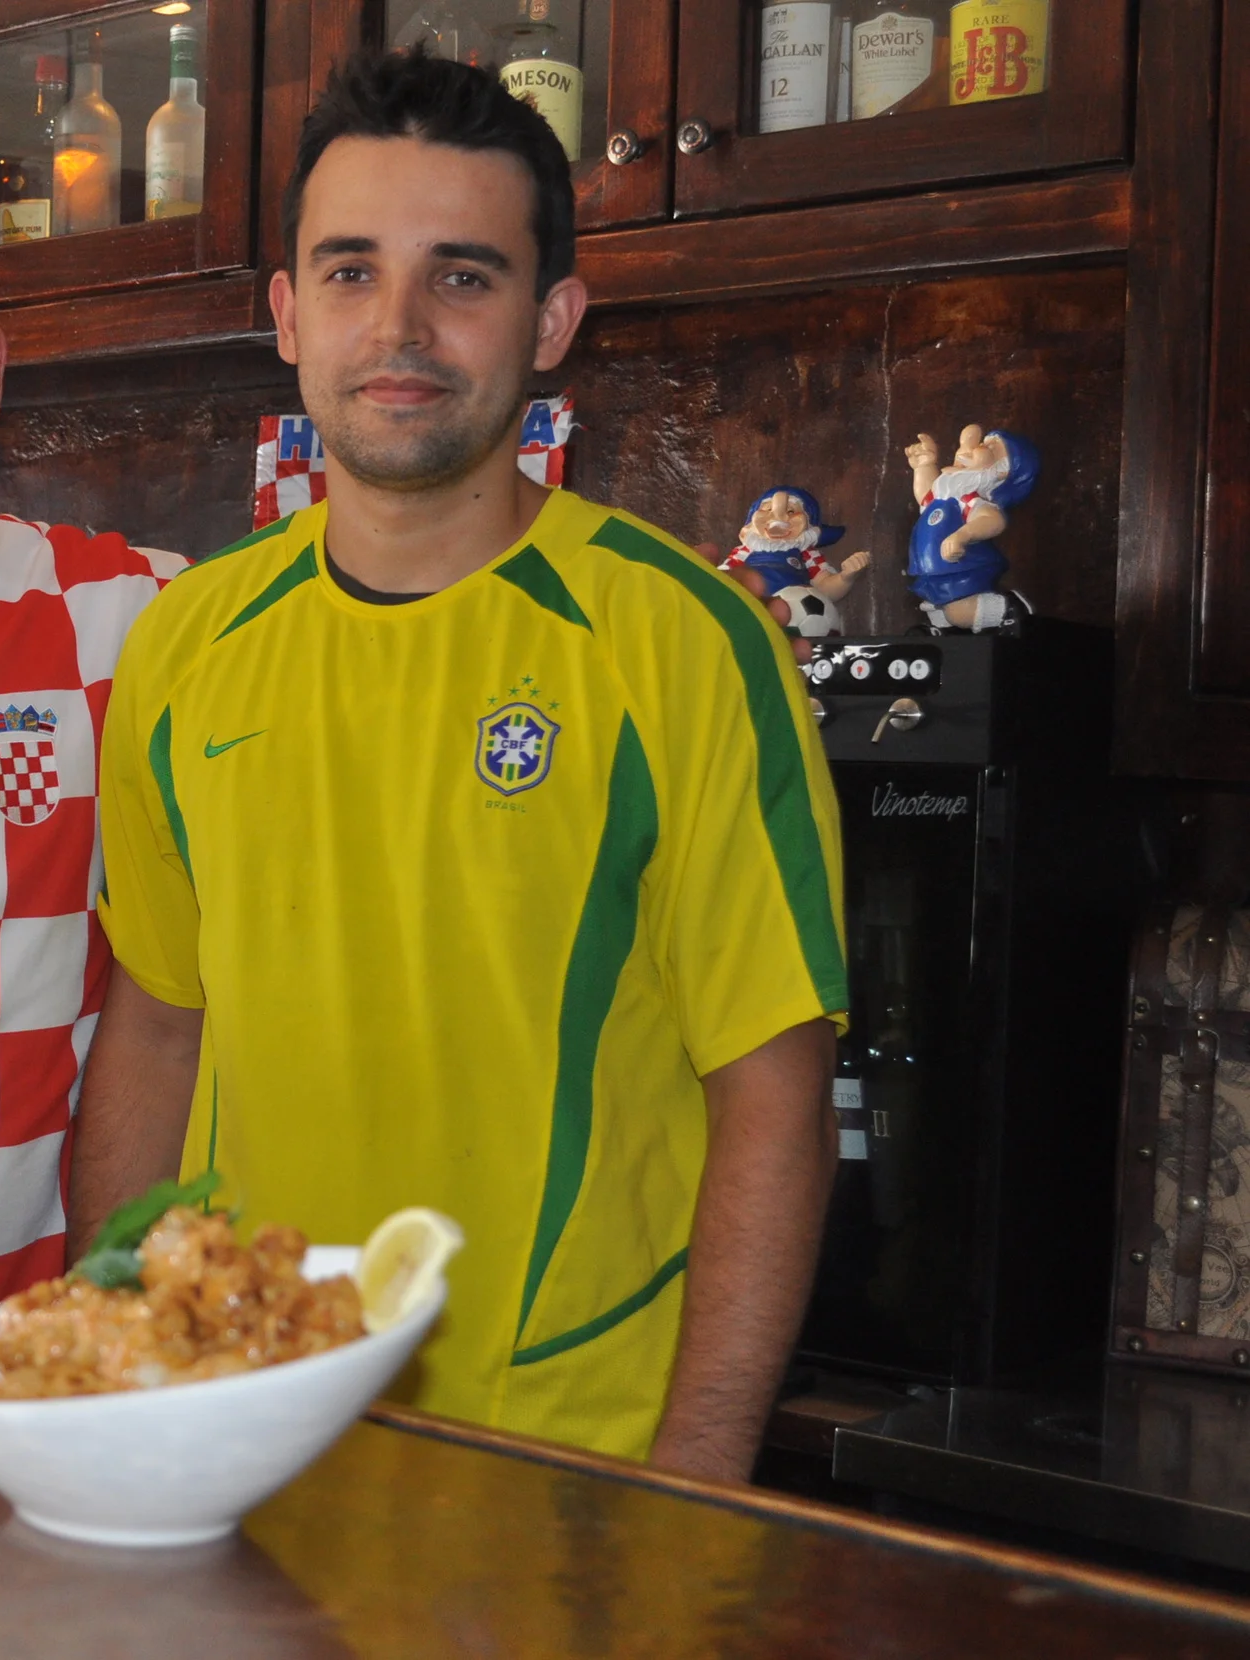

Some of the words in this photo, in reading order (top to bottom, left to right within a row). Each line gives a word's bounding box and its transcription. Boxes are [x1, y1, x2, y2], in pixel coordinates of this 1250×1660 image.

[972, 15, 1010, 26] RARE
[768, 30, 789, 45] The
[857, 29, 925, 52] Dewar's
[762, 43, 823, 61] CALLAN
[862, 49, 889, 61] White
[890, 47, 918, 57] Label
[955, 26, 1029, 100] J&B
[770, 77, 789, 98] 12
[500, 739, 528, 750] CBF
[484, 800, 527, 813] BRASIL
[871, 781, 967, 822] Vinotemp
